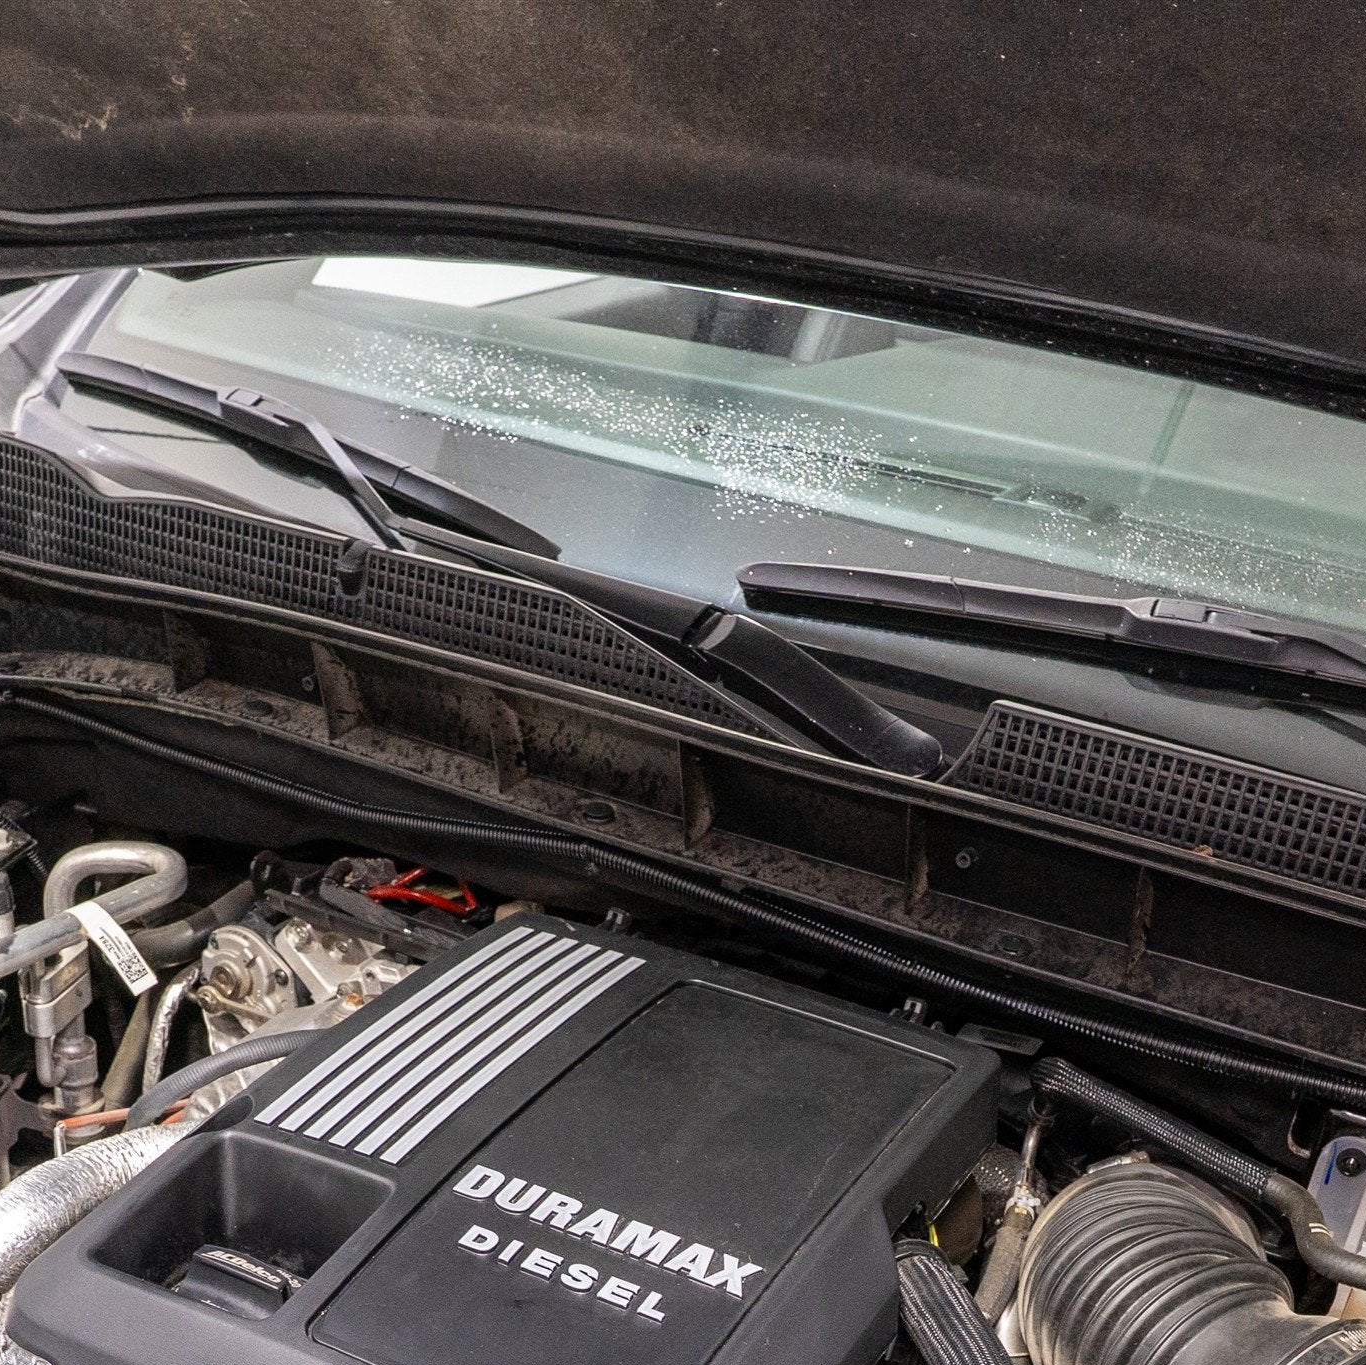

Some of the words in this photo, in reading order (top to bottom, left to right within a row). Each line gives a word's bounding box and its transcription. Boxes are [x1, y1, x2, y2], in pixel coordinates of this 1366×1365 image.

[202, 1250, 282, 1283] ACDelco
[452, 1164, 763, 1299] DURAMAX
[458, 1224, 667, 1323] DIESEL
